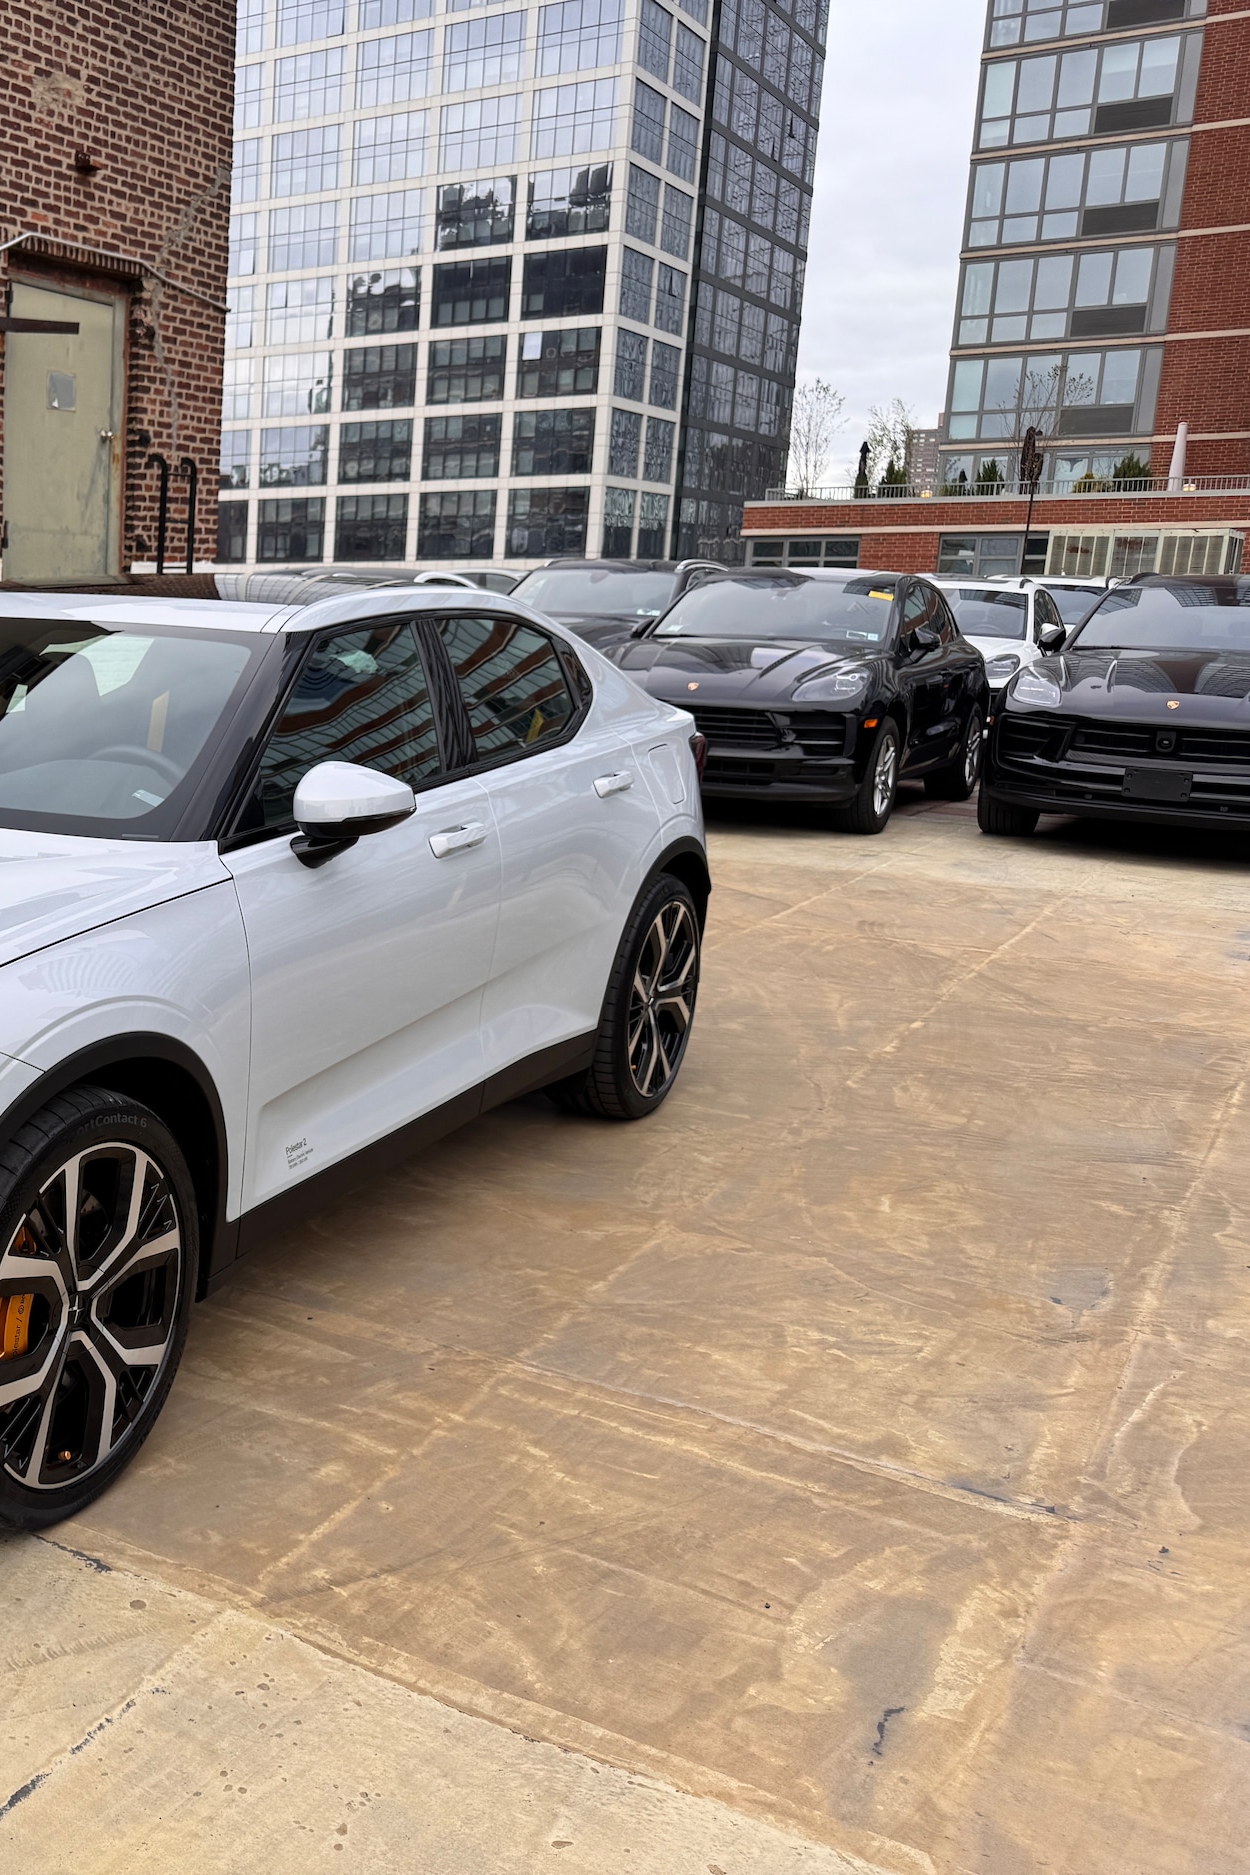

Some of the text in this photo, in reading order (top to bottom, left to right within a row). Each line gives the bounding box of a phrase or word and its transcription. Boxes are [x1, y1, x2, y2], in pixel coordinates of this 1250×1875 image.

[140, 1117, 148, 1129] 6
[286, 1138, 307, 1155] Polestar 2
[13, 1324, 21, 1357] olestar
